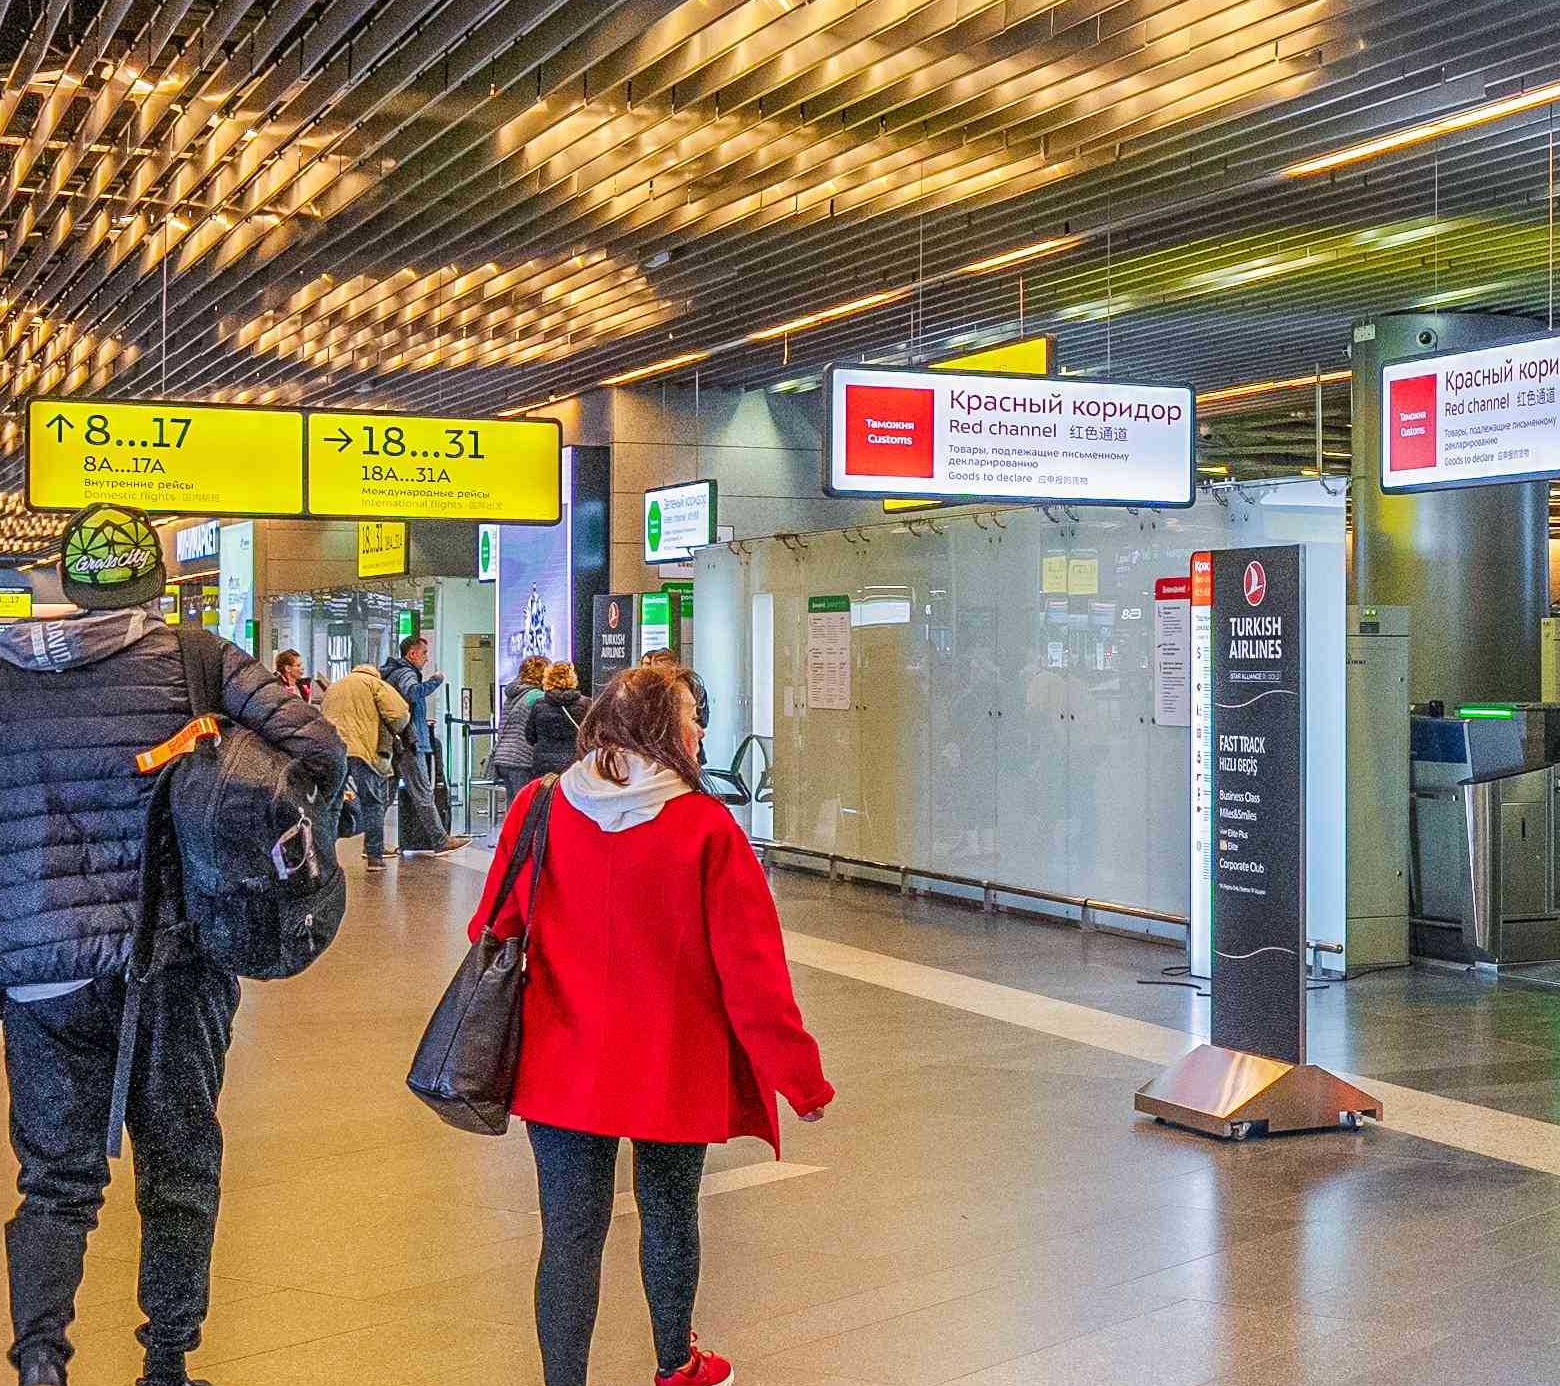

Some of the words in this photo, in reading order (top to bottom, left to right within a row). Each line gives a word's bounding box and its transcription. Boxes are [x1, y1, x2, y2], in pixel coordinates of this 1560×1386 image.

[1445, 358, 1514, 396] Красный
[950, 389, 1063, 419] Красный
[1072, 398, 1182, 425] коридор
[1444, 400, 1465, 417] Red
[1467, 393, 1510, 415] channel
[84, 414, 193, 449] 8...17
[866, 417, 915, 431] Таможня
[949, 419, 983, 437] Red
[988, 420, 1058, 439] channel
[1069, 425, 1129, 442] 红色通道
[1400, 425, 1426, 437] Customs
[362, 426, 485, 460] 18...31
[867, 433, 913, 446] Customs
[948, 445, 989, 456] Товары,
[991, 447, 1060, 459] подлежащие
[1061, 450, 1130, 462] письменному
[948, 458, 1039, 470] декларированию
[84, 478, 154, 489] Внутренние
[157, 480, 194, 490] рейсы
[948, 471, 980, 482] Goods
[983, 473, 994, 482] to
[996, 473, 1032, 483] declare
[361, 487, 454, 499] Международные
[457, 489, 490, 500] рейсы
[1229, 616, 1281, 636] TURKISH
[1229, 639, 1282, 659] AIRLINES
[1219, 735, 1238, 752] FAST
[1239, 736, 1265, 754] TRACK
[1219, 757, 1236, 772] HIZLI
[1219, 790, 1244, 802] Business
[1245, 791, 1260, 803] Class
[1219, 807, 1257, 821] Miles&Smiles
[1219, 858, 1249, 872] Corporate
